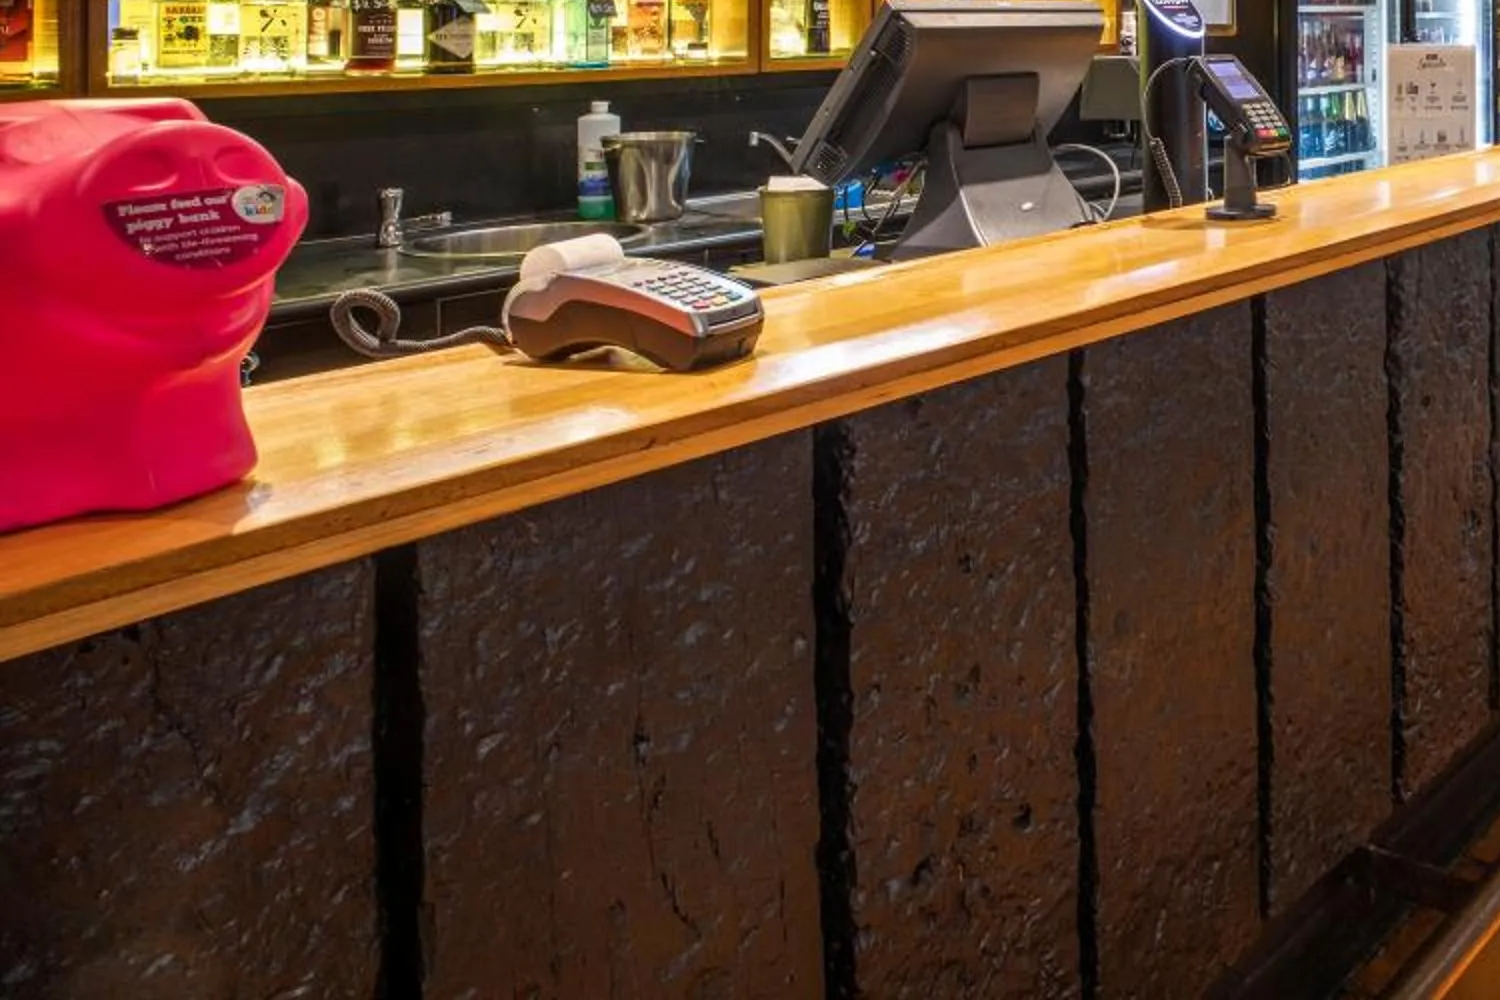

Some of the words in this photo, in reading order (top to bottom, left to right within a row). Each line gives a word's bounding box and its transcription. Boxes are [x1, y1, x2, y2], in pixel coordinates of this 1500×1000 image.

[117, 201, 168, 218] Please
[170, 195, 202, 210] feed
[204, 192, 229, 206] our
[125, 217, 175, 235] piggy
[178, 210, 221, 225] bank
